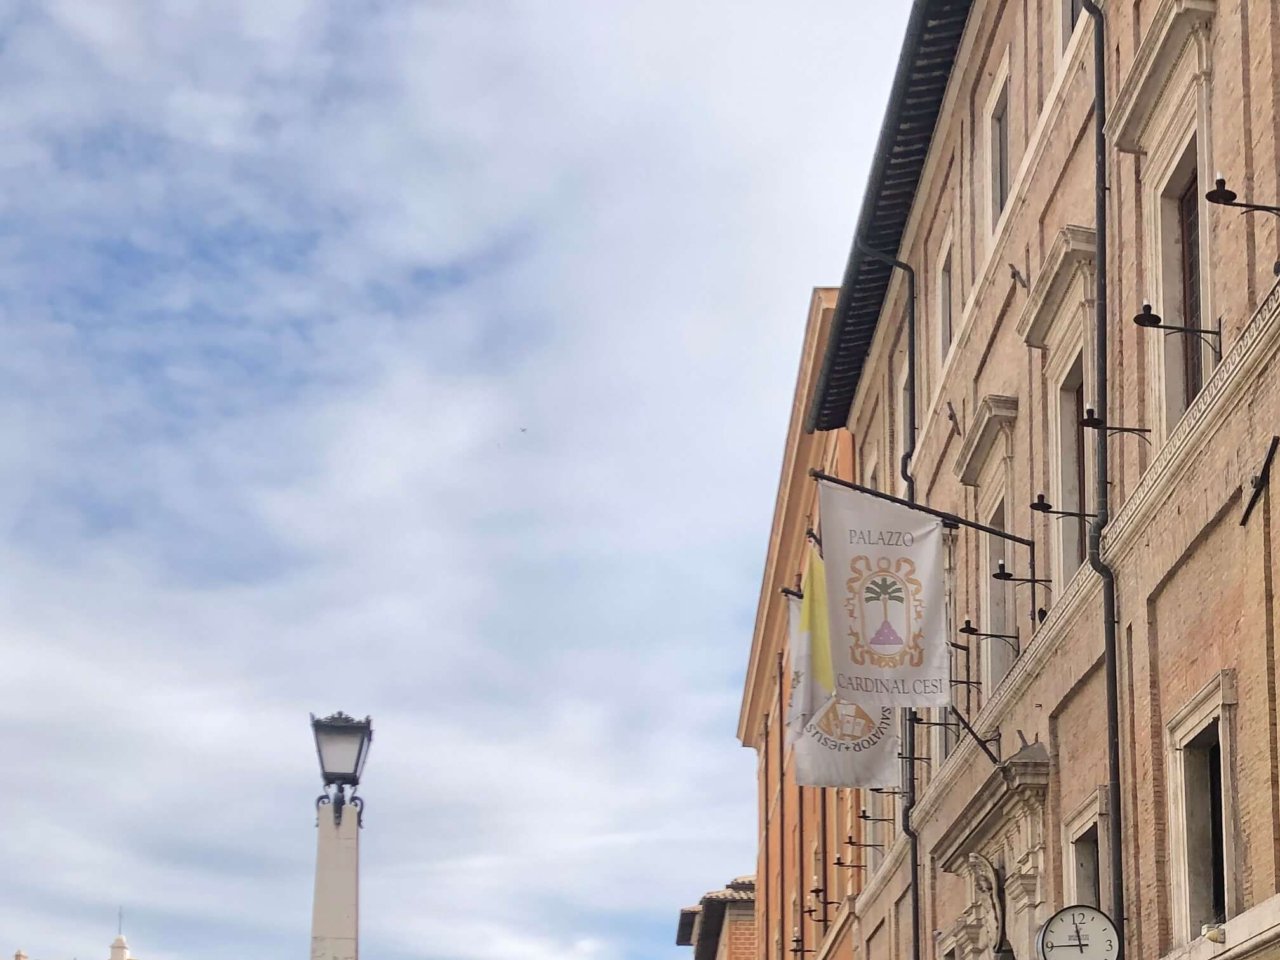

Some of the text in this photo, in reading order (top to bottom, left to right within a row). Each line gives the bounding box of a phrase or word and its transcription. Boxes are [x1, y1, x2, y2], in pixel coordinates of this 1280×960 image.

[849, 528, 914, 547] PALAZZO
[837, 673, 944, 694] CARDINAL CESI
[1072, 912, 1086, 925] 12
[1045, 941, 1054, 953] 9
[1105, 939, 1113, 952] 3
